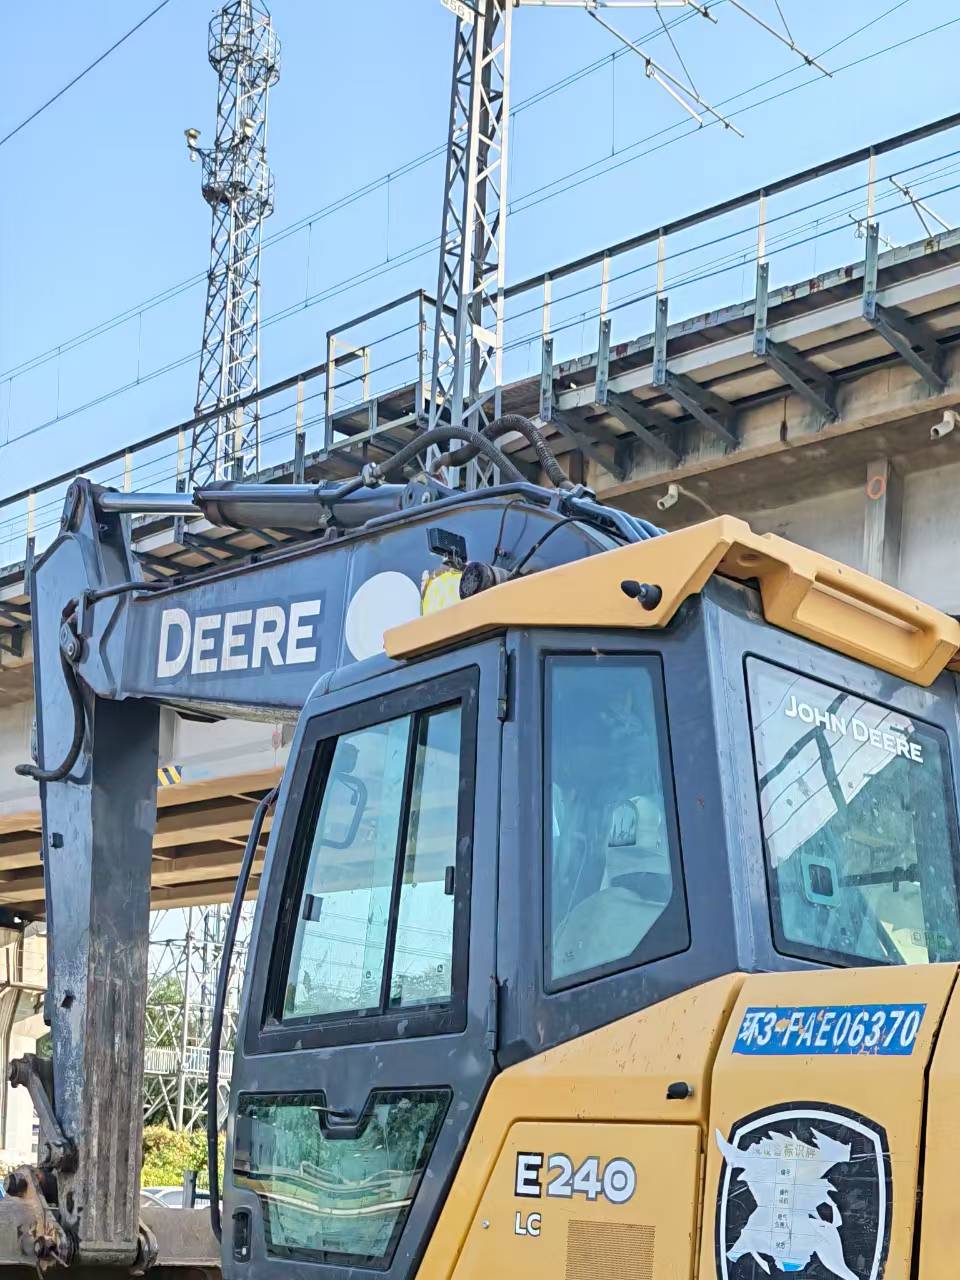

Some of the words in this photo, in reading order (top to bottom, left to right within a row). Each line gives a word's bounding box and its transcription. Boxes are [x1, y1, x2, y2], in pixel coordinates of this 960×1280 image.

[157, 600, 321, 678] DEERE
[785, 695, 848, 736] JOHN
[852, 717, 924, 764] DEERE
[514, 1151, 637, 1204] E240
[514, 1211, 542, 1237] LC
